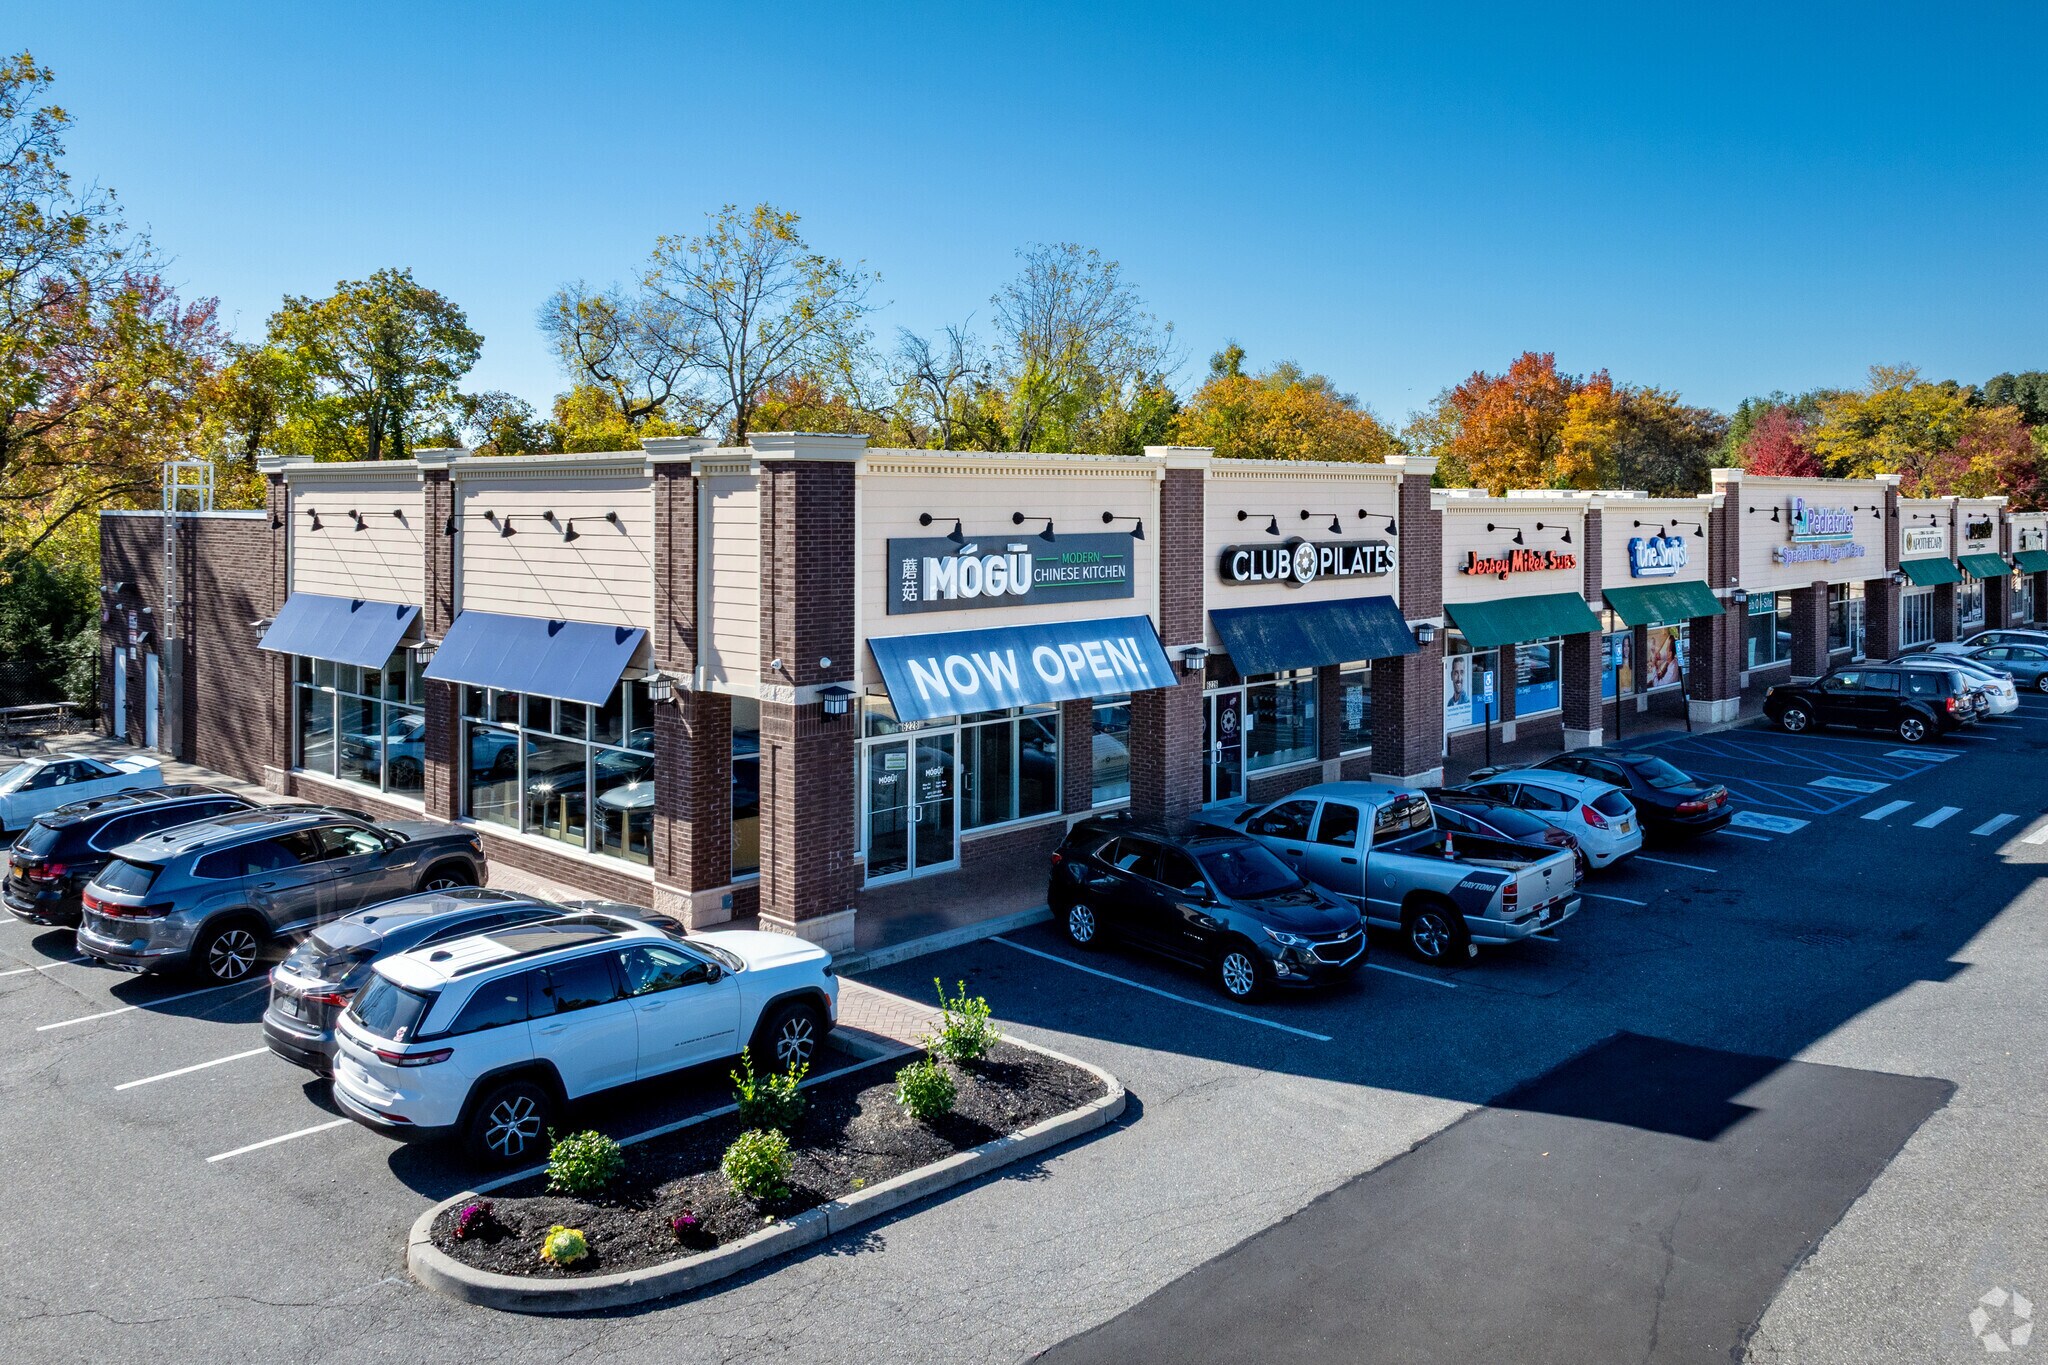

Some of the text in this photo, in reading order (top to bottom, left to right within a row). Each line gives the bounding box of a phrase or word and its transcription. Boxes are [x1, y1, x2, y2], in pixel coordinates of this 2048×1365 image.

[1808, 507, 1854, 534] Pediatrics
[1062, 551, 1100, 564] MODERN
[1232, 545, 1396, 581] CLUB PILATES
[1467, 550, 1509, 580] Jersey
[1782, 545, 1825, 567] Specialized
[902, 558, 918, 602] 蘑菇
[1034, 564, 1126, 582] CHINESE KITCHEN
[908, 637, 1148, 700] NOW OPEN!
[902, 720, 920, 732] 6228
[1459, 880, 1497, 893] DAYTONA
